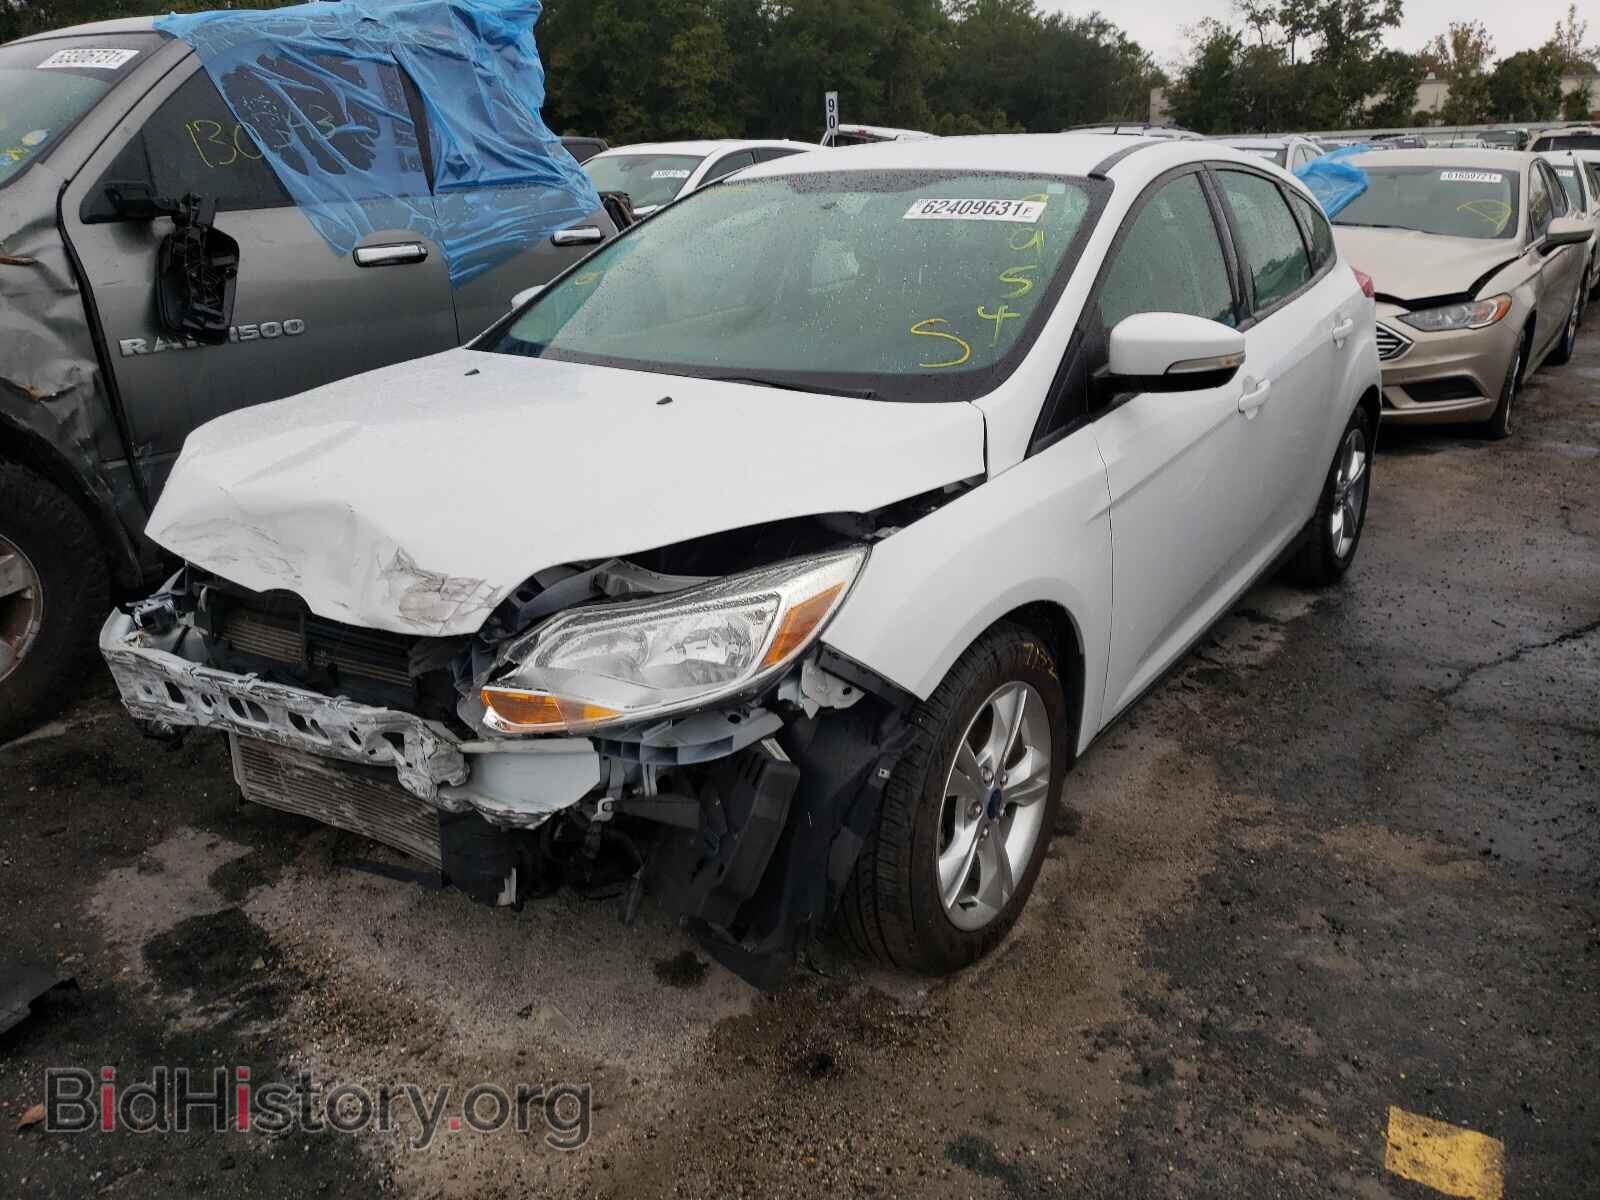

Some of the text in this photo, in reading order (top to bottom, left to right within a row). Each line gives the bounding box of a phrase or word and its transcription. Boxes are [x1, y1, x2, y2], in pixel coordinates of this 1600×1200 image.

[828, 98, 836, 129] 90
[921, 200, 1025, 216] 62409631
[229, 319, 305, 343] 1500
